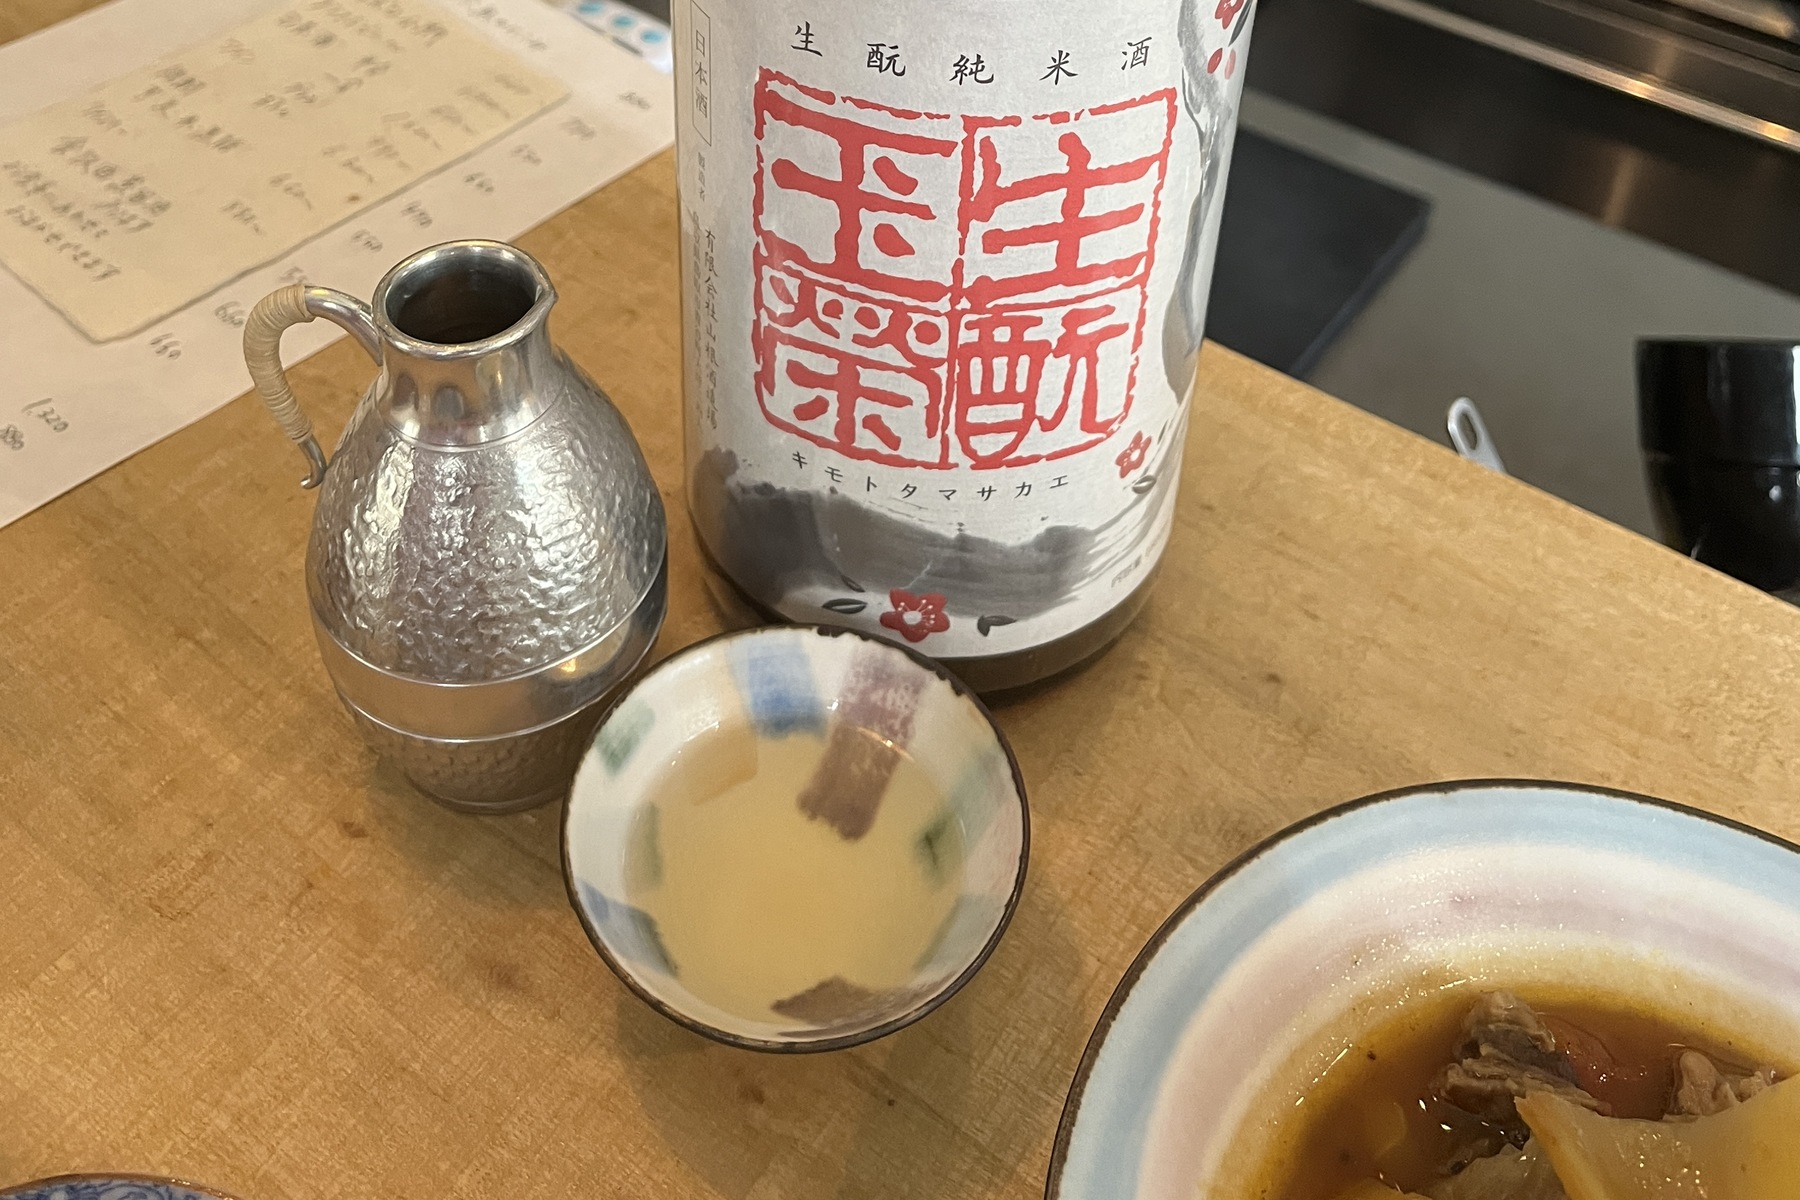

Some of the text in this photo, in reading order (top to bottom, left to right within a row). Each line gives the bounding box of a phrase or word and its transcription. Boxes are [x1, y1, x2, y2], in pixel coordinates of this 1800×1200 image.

[695, 29, 708, 119] 日本酒
[790, 22, 1153, 86] 生酛純米酒
[792, 450, 1070, 502] キモトタマサカエ
